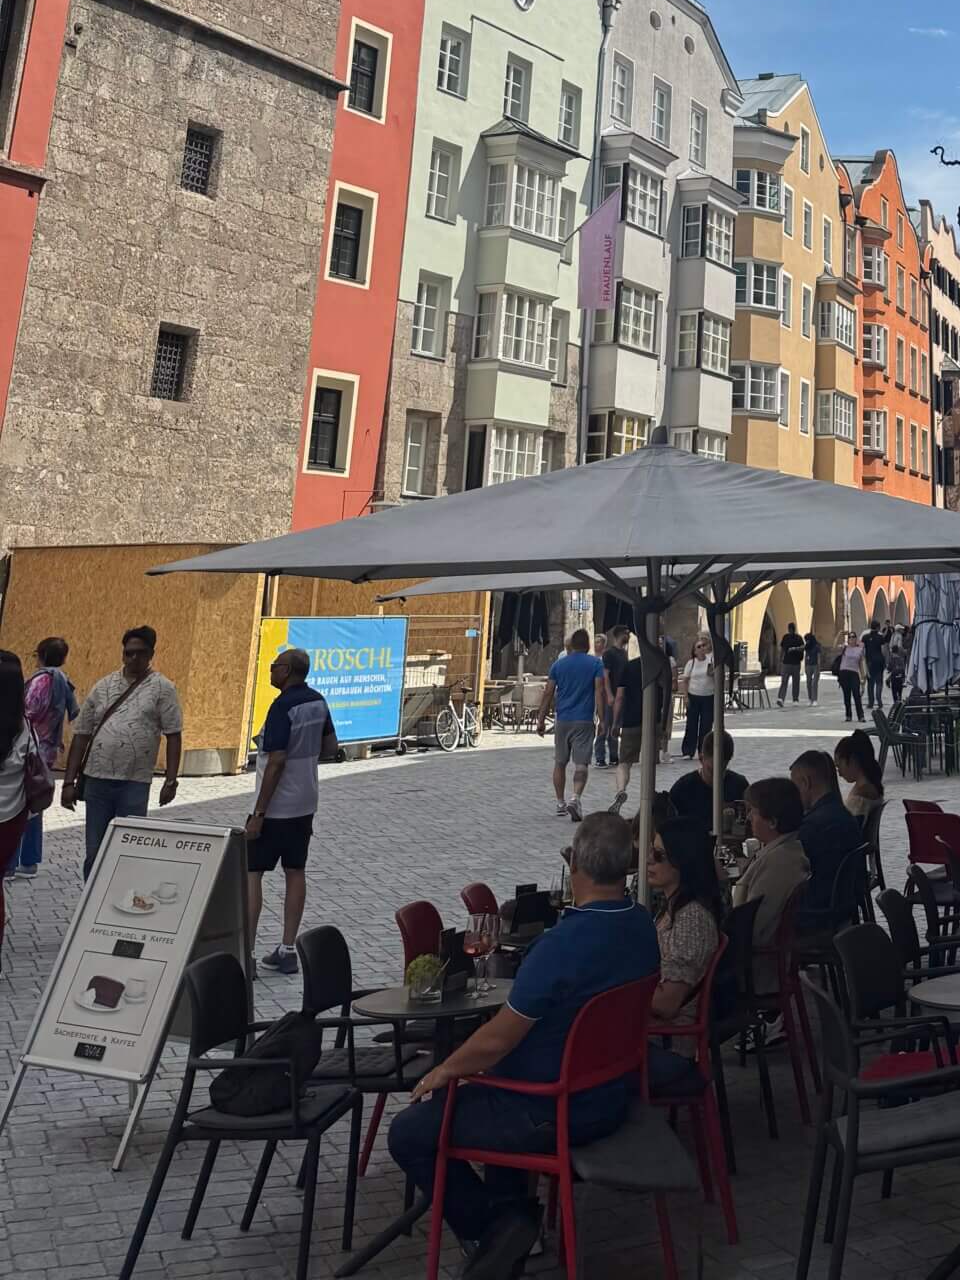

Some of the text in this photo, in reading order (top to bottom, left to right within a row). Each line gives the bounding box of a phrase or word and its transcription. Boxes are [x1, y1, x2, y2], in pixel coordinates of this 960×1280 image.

[602, 233, 613, 302] FRAUENLAUF
[120, 833, 211, 853] SPECIAL OFFER
[150, 935, 175, 945] KAFFEE
